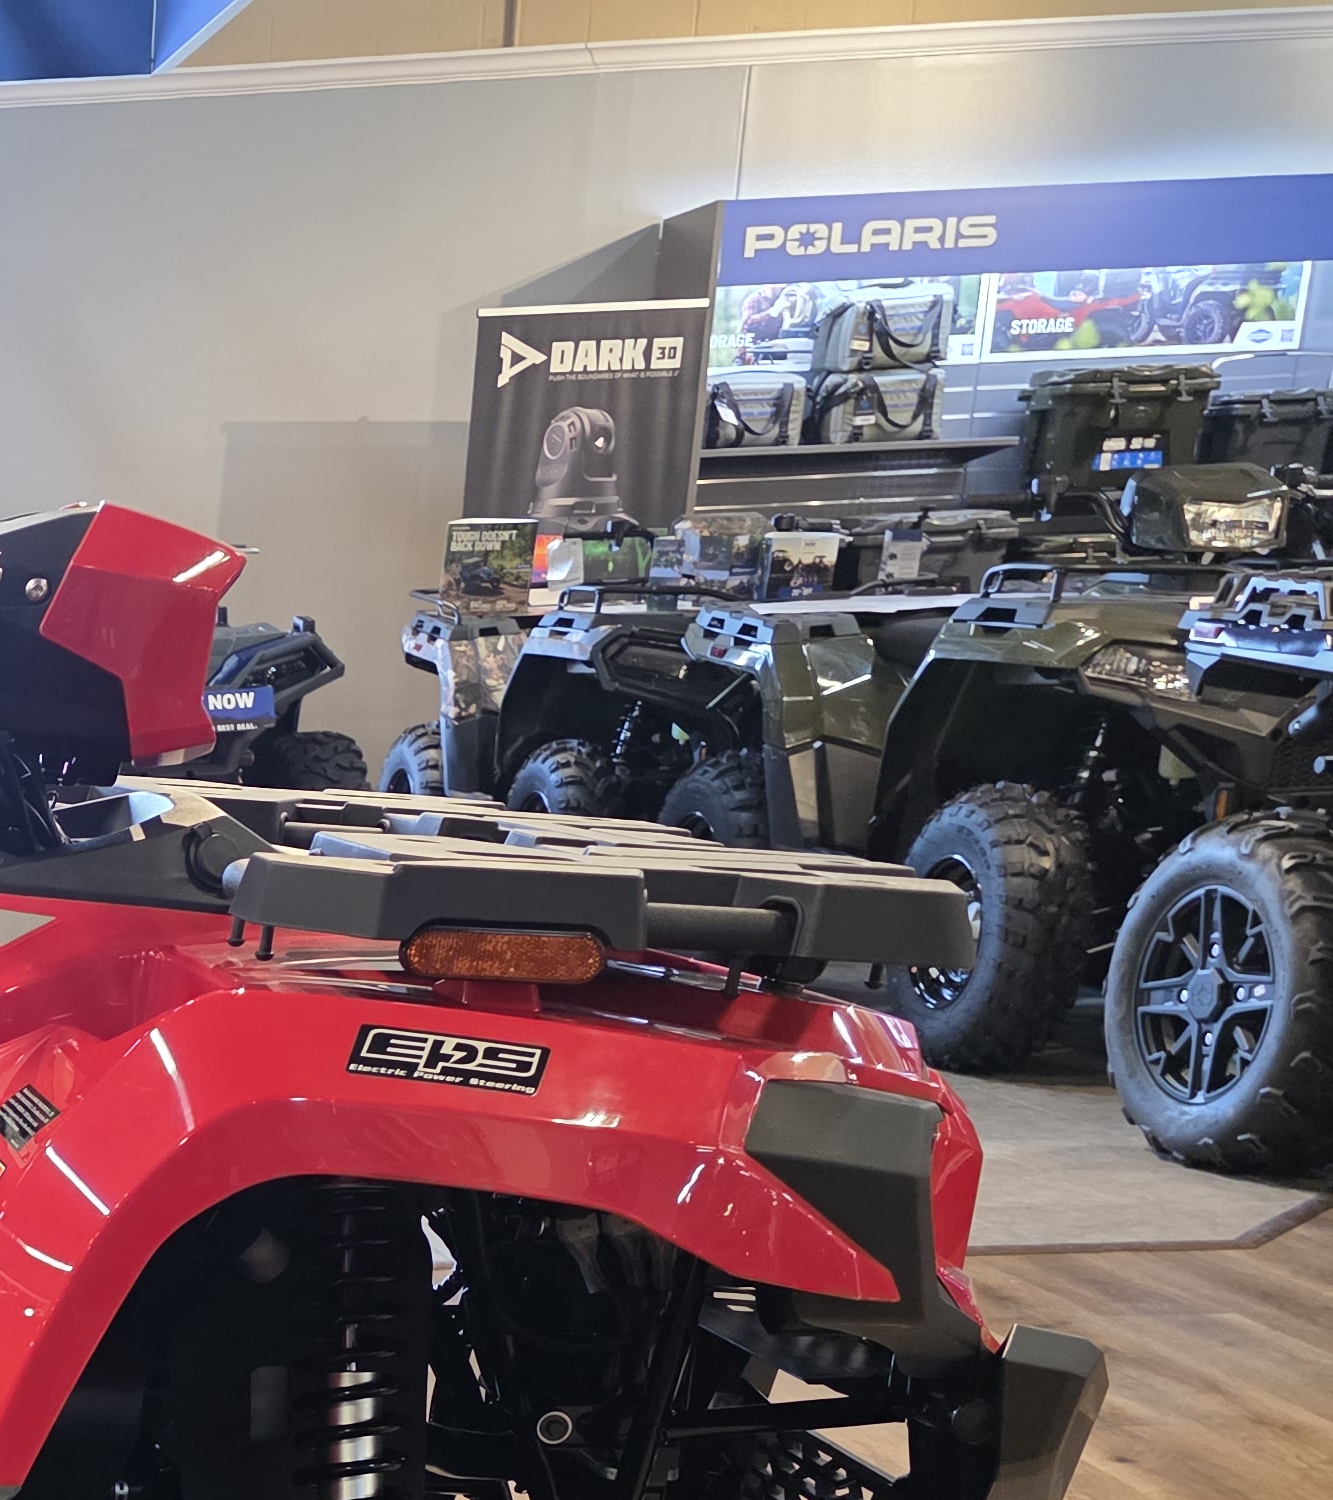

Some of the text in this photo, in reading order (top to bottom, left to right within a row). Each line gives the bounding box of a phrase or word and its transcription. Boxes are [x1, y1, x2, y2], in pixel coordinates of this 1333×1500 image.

[744, 215, 998, 258] POLARIS
[1010, 317, 1076, 335] STORAGE
[549, 338, 648, 373] DARK
[450, 541, 501, 552] BACK DOWN
[452, 530, 518, 542] TOUGH DOESN'T
[207, 691, 255, 710] NOW
[360, 1028, 541, 1078] EPS
[348, 1063, 536, 1094] Electric Power Steering
